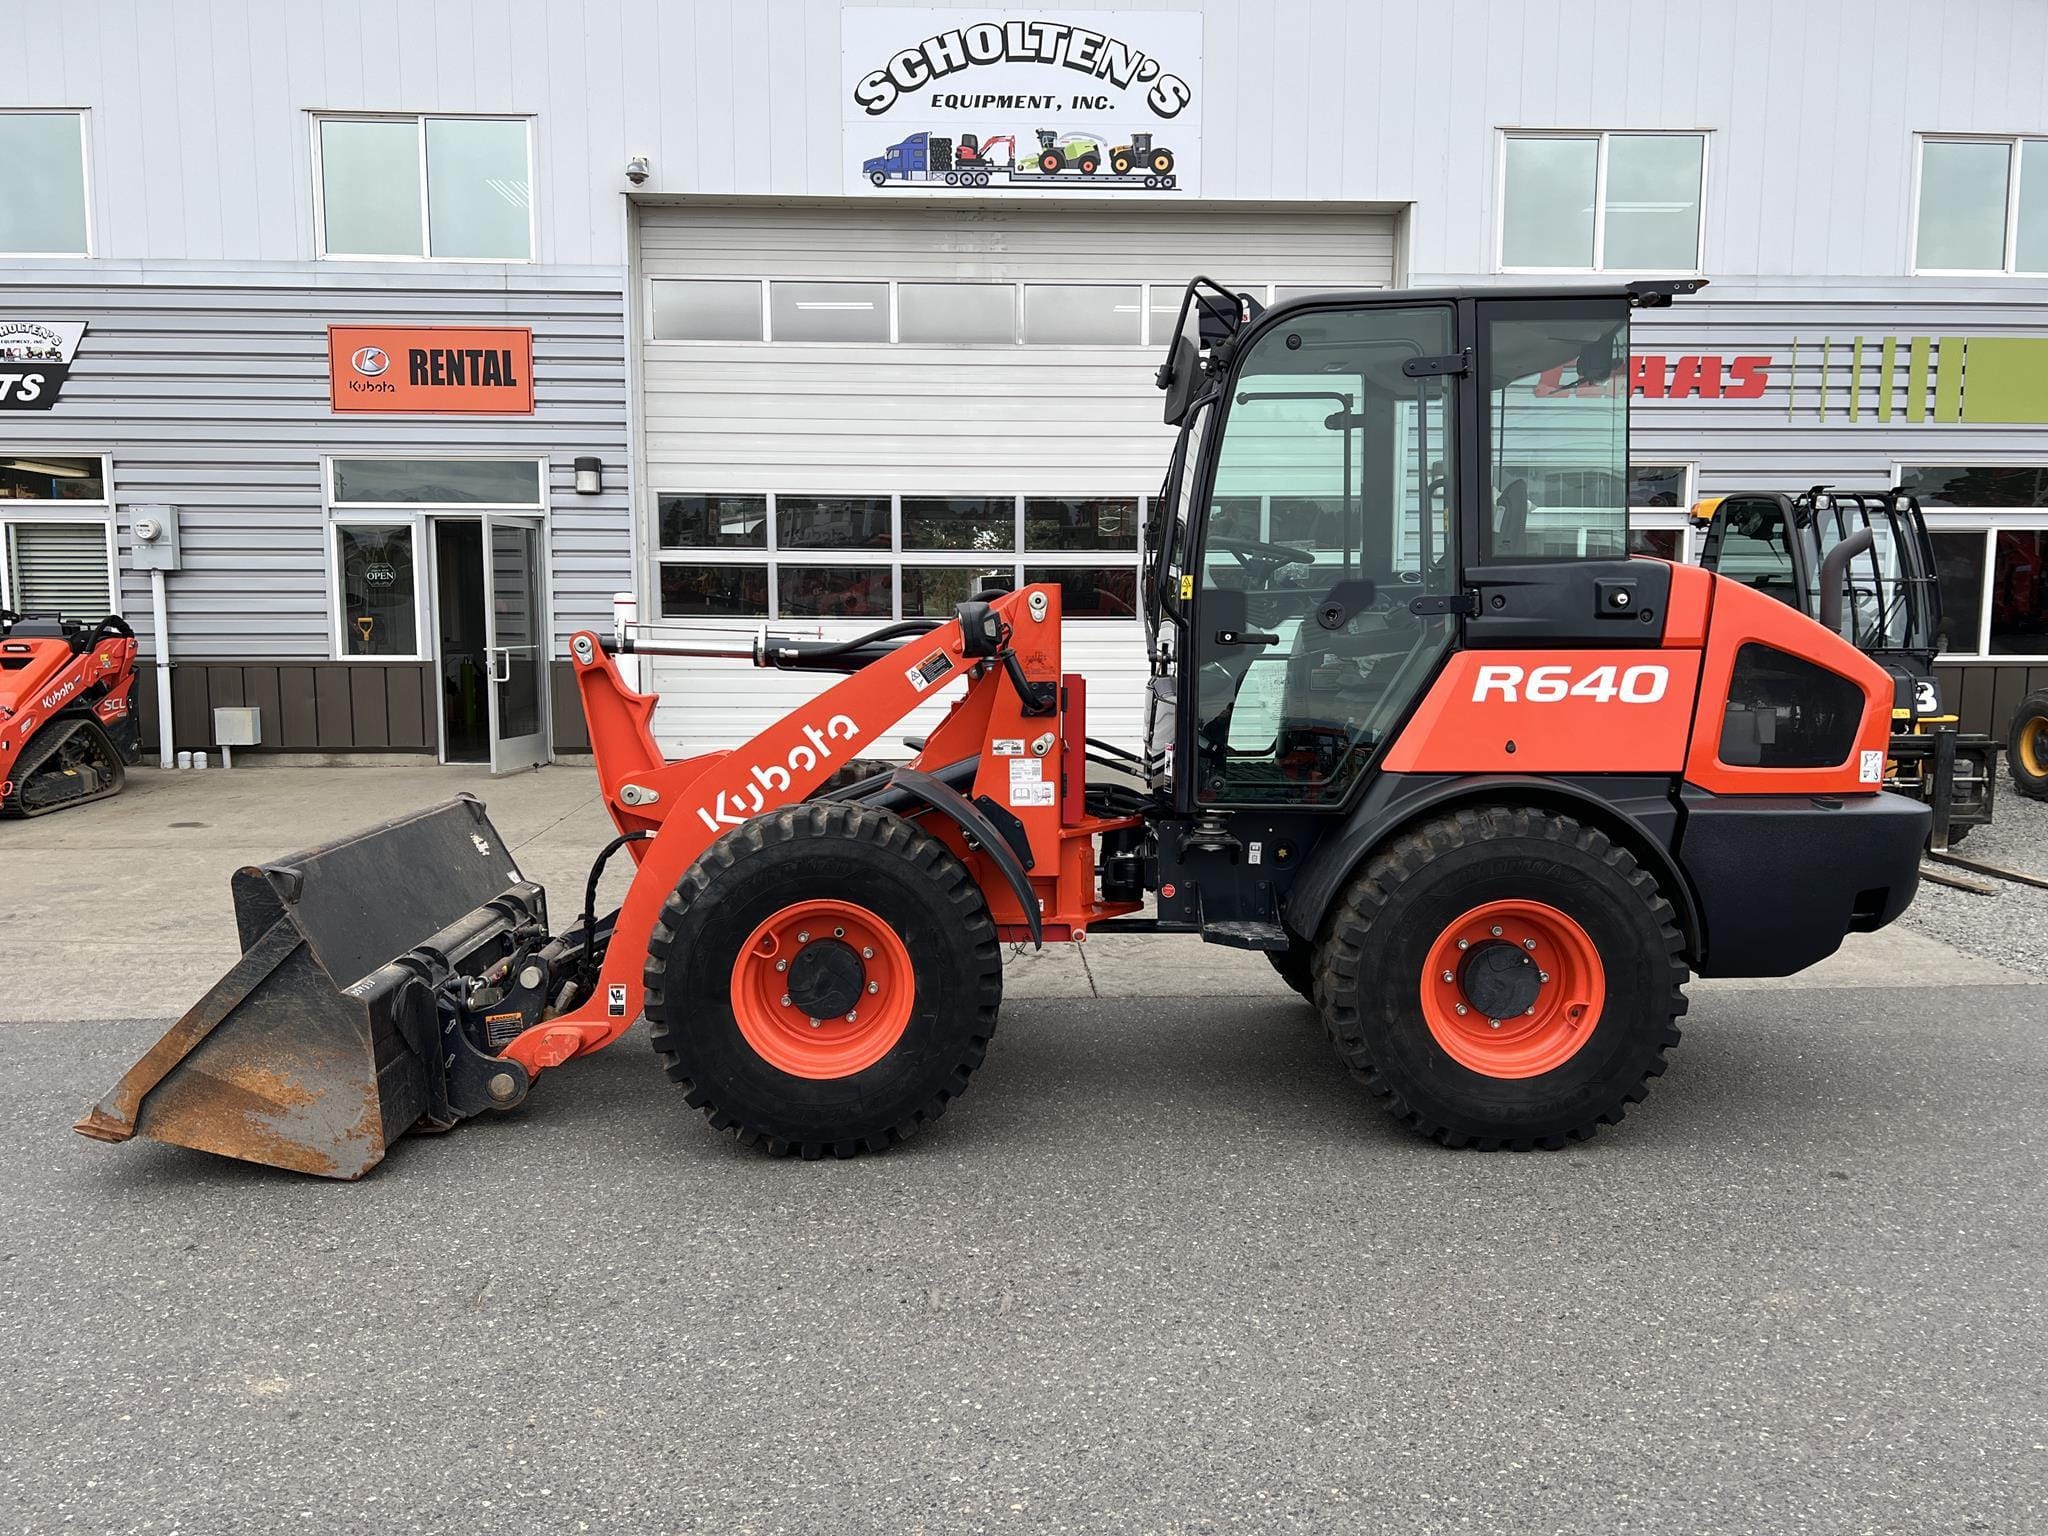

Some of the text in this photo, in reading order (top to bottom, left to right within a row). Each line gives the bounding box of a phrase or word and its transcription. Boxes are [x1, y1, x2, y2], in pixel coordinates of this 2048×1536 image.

[854, 21, 1191, 119] SCHOLTEN'S
[931, 94, 1116, 111] EQUIPMENT, INC.
[408, 348, 517, 387] RENTAL
[349, 380, 395, 393] Kubota
[367, 571, 394, 580] OPEN
[41, 681, 75, 708] Kubota
[1472, 665, 1669, 704] R640
[103, 697, 127, 711] SCL
[696, 714, 860, 833] Kubota
